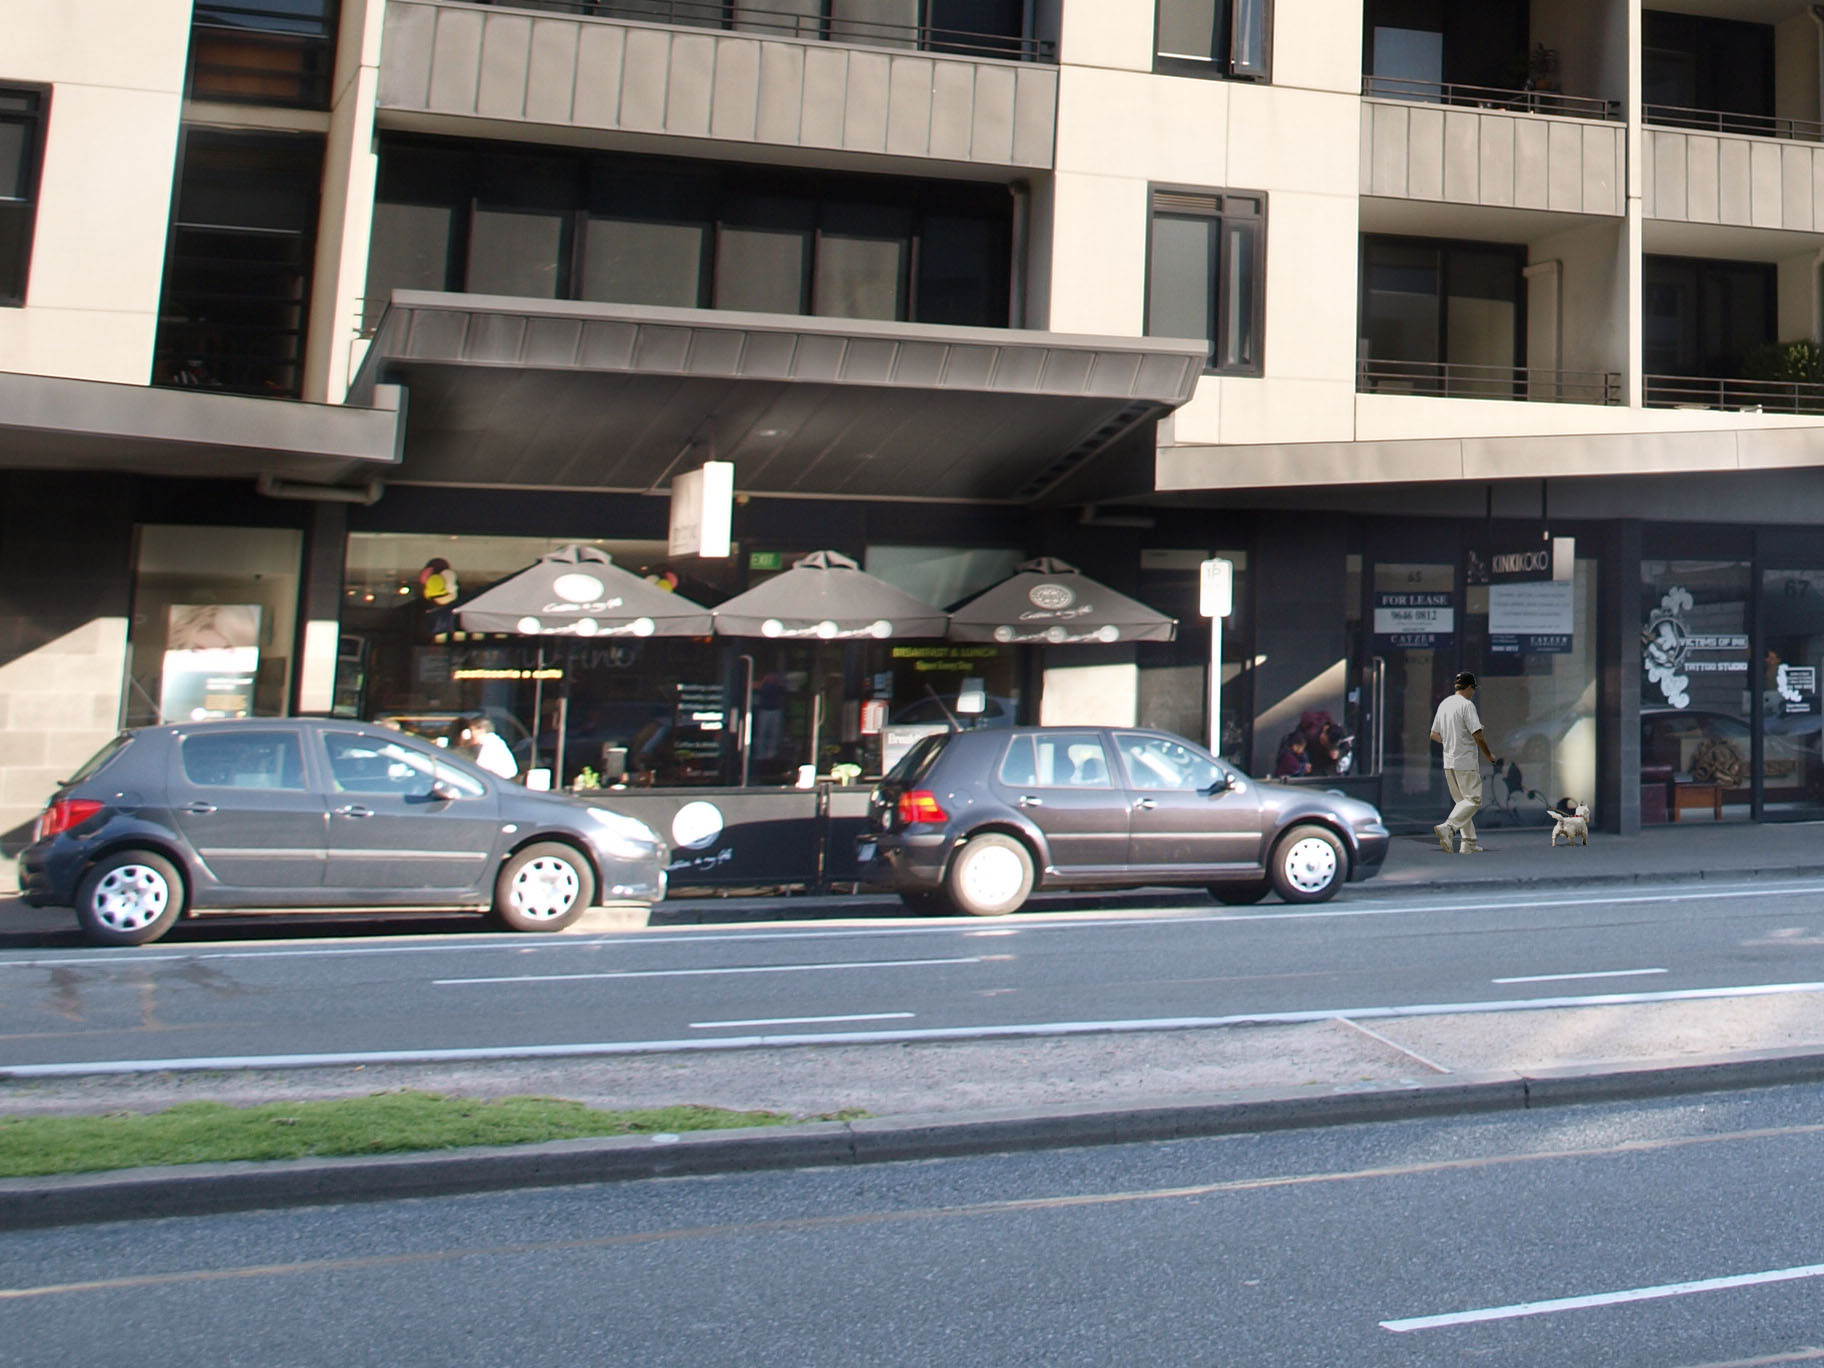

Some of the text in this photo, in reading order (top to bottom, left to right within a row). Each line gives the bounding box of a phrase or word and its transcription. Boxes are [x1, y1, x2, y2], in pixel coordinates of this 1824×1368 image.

[1784, 579, 1809, 598] 67
[1382, 595, 1448, 606] FOR LEASE
[1679, 637, 1716, 647] VICTIMS
[1717, 637, 1731, 647] OF
[1684, 661, 1748, 672] TATTOO STUDIO
